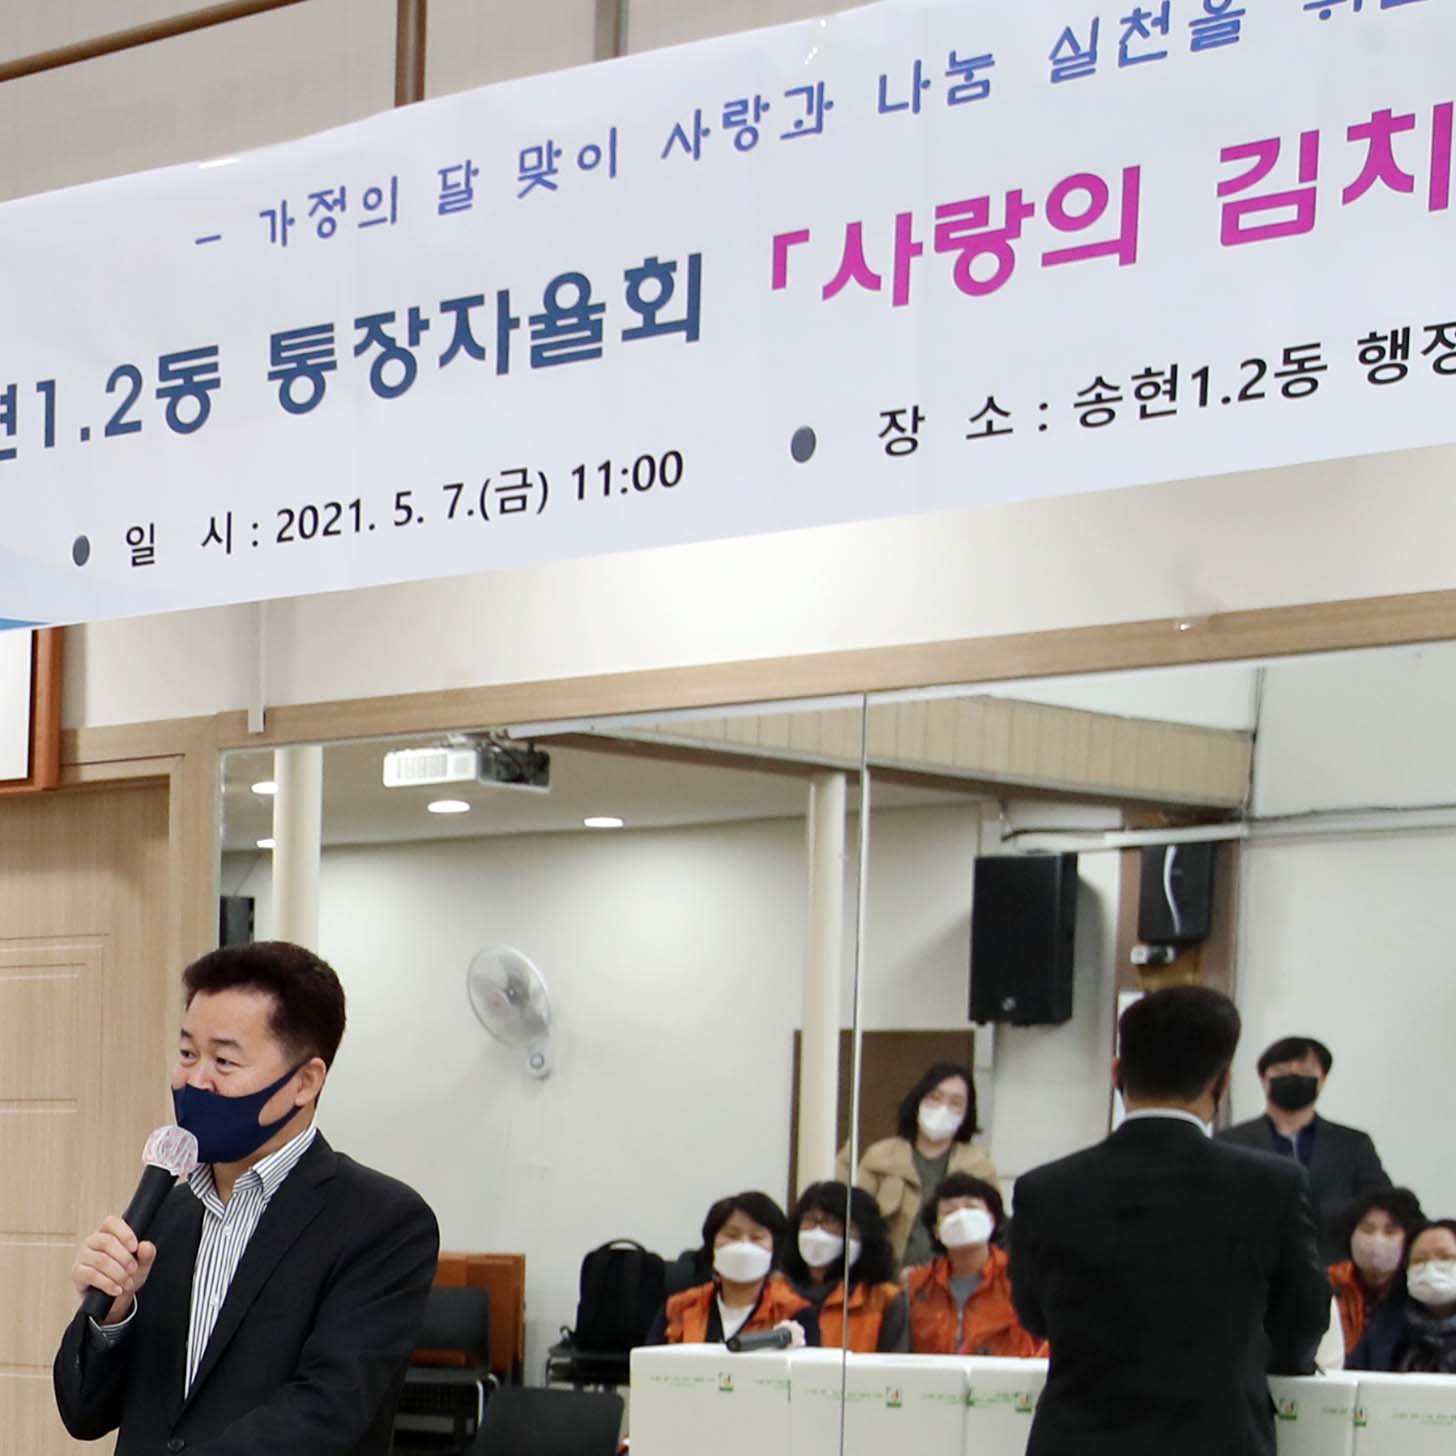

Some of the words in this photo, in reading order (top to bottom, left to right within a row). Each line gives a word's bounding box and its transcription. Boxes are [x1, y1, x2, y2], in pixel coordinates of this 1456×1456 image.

[258, 176, 398, 248] 가정의
[437, 160, 480, 216] 달
[517, 127, 618, 200] 맞이
[661, 82, 833, 161] 사랑과
[877, 51, 995, 115] 나눔
[1048, 0, 1246, 85] 실천을
[267, 252, 703, 415] 통장자율회
[1216, 101, 1456, 246] 김치
[125, 523, 157, 568] 일
[275, 496, 376, 545] 2021.
[571, 448, 685, 502] 11:00
[877, 405, 925, 458] 장
[1072, 342, 1328, 429] 송현1.2동
